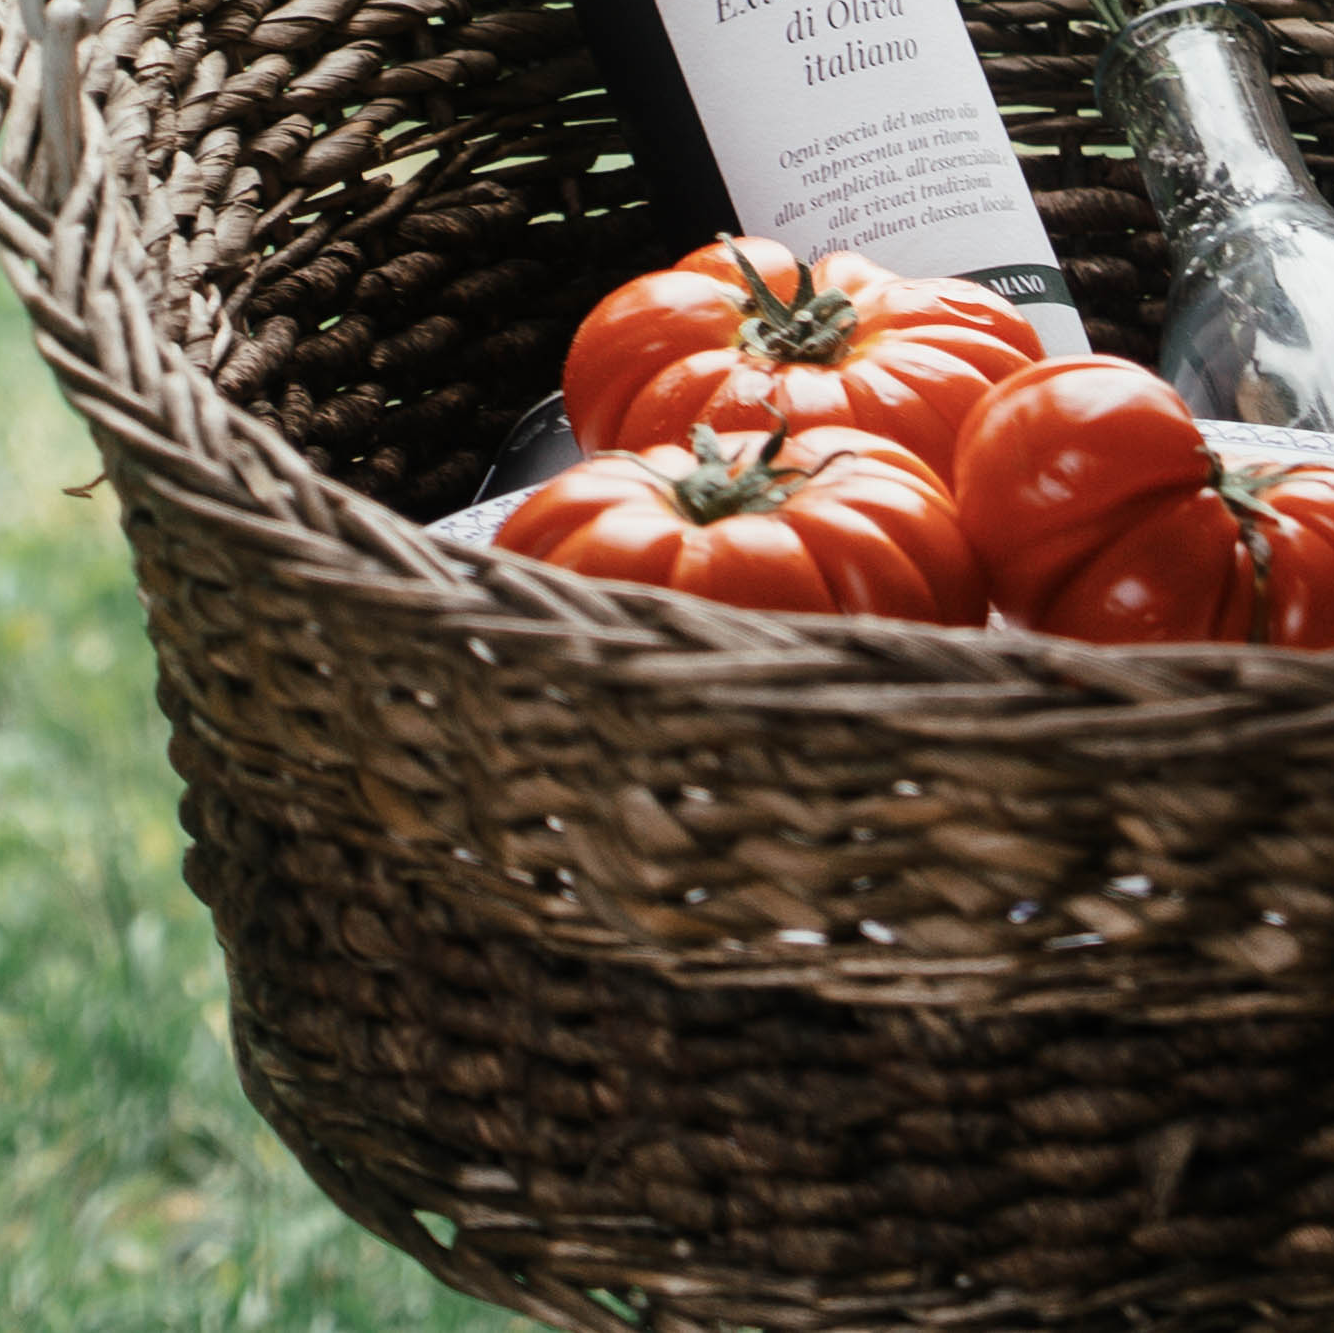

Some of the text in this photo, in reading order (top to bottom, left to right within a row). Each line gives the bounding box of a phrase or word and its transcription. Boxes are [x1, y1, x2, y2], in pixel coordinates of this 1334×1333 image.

[786, 7, 815, 44] di
[804, 38, 918, 86] italiano
[779, 138, 820, 169] Ogni
[824, 122, 878, 156] goccia
[882, 112, 907, 133] del
[910, 107, 956, 126] nostro
[802, 142, 904, 187] rappresenta
[907, 137, 929, 152] un
[774, 202, 806, 227] alla
[828, 172, 993, 230] alle vivaci tradizioni
[853, 215, 916, 247] cultura
[921, 199, 979, 226] classica
